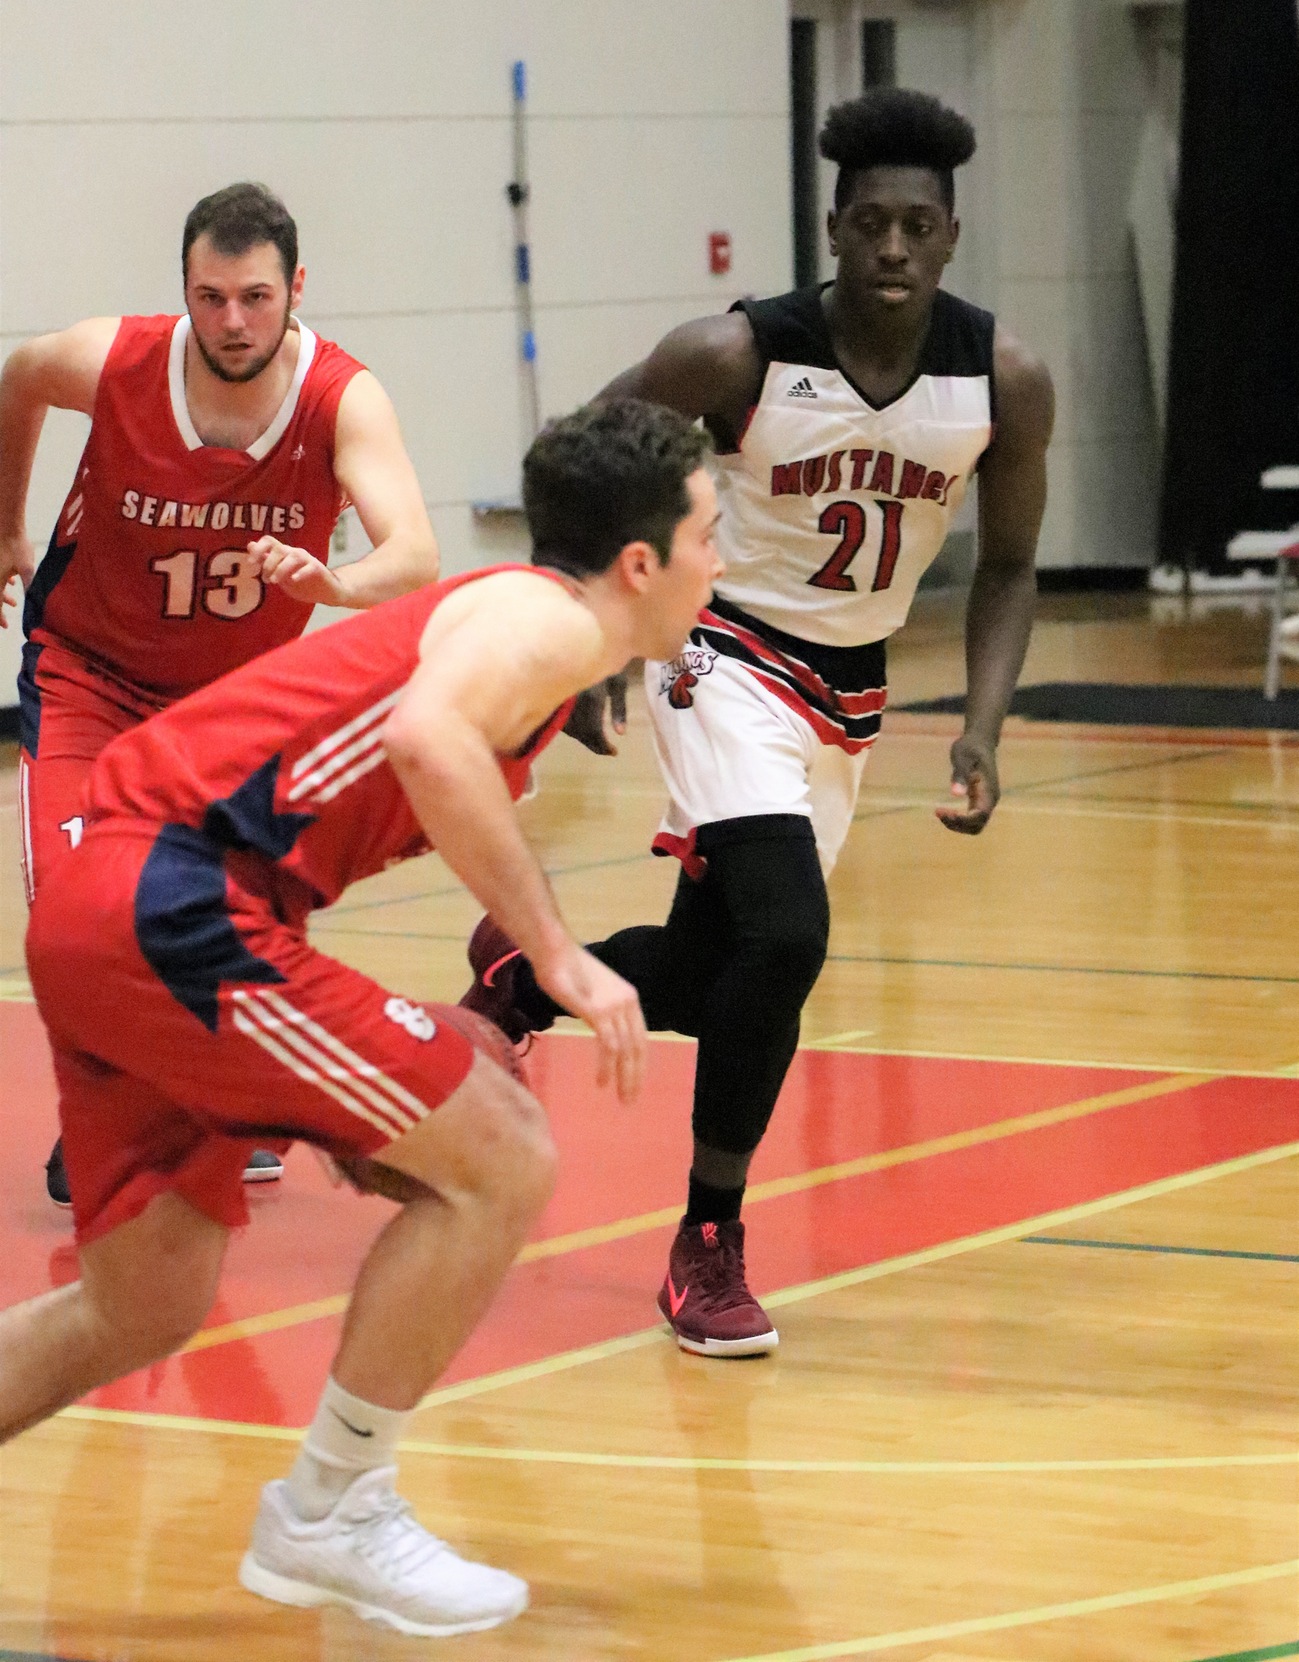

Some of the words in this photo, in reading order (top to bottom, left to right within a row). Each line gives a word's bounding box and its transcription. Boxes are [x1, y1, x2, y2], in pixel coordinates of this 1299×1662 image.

[121, 488, 306, 533] SEAWOLVES
[806, 499, 905, 593] 21
[150, 547, 266, 621] 13
